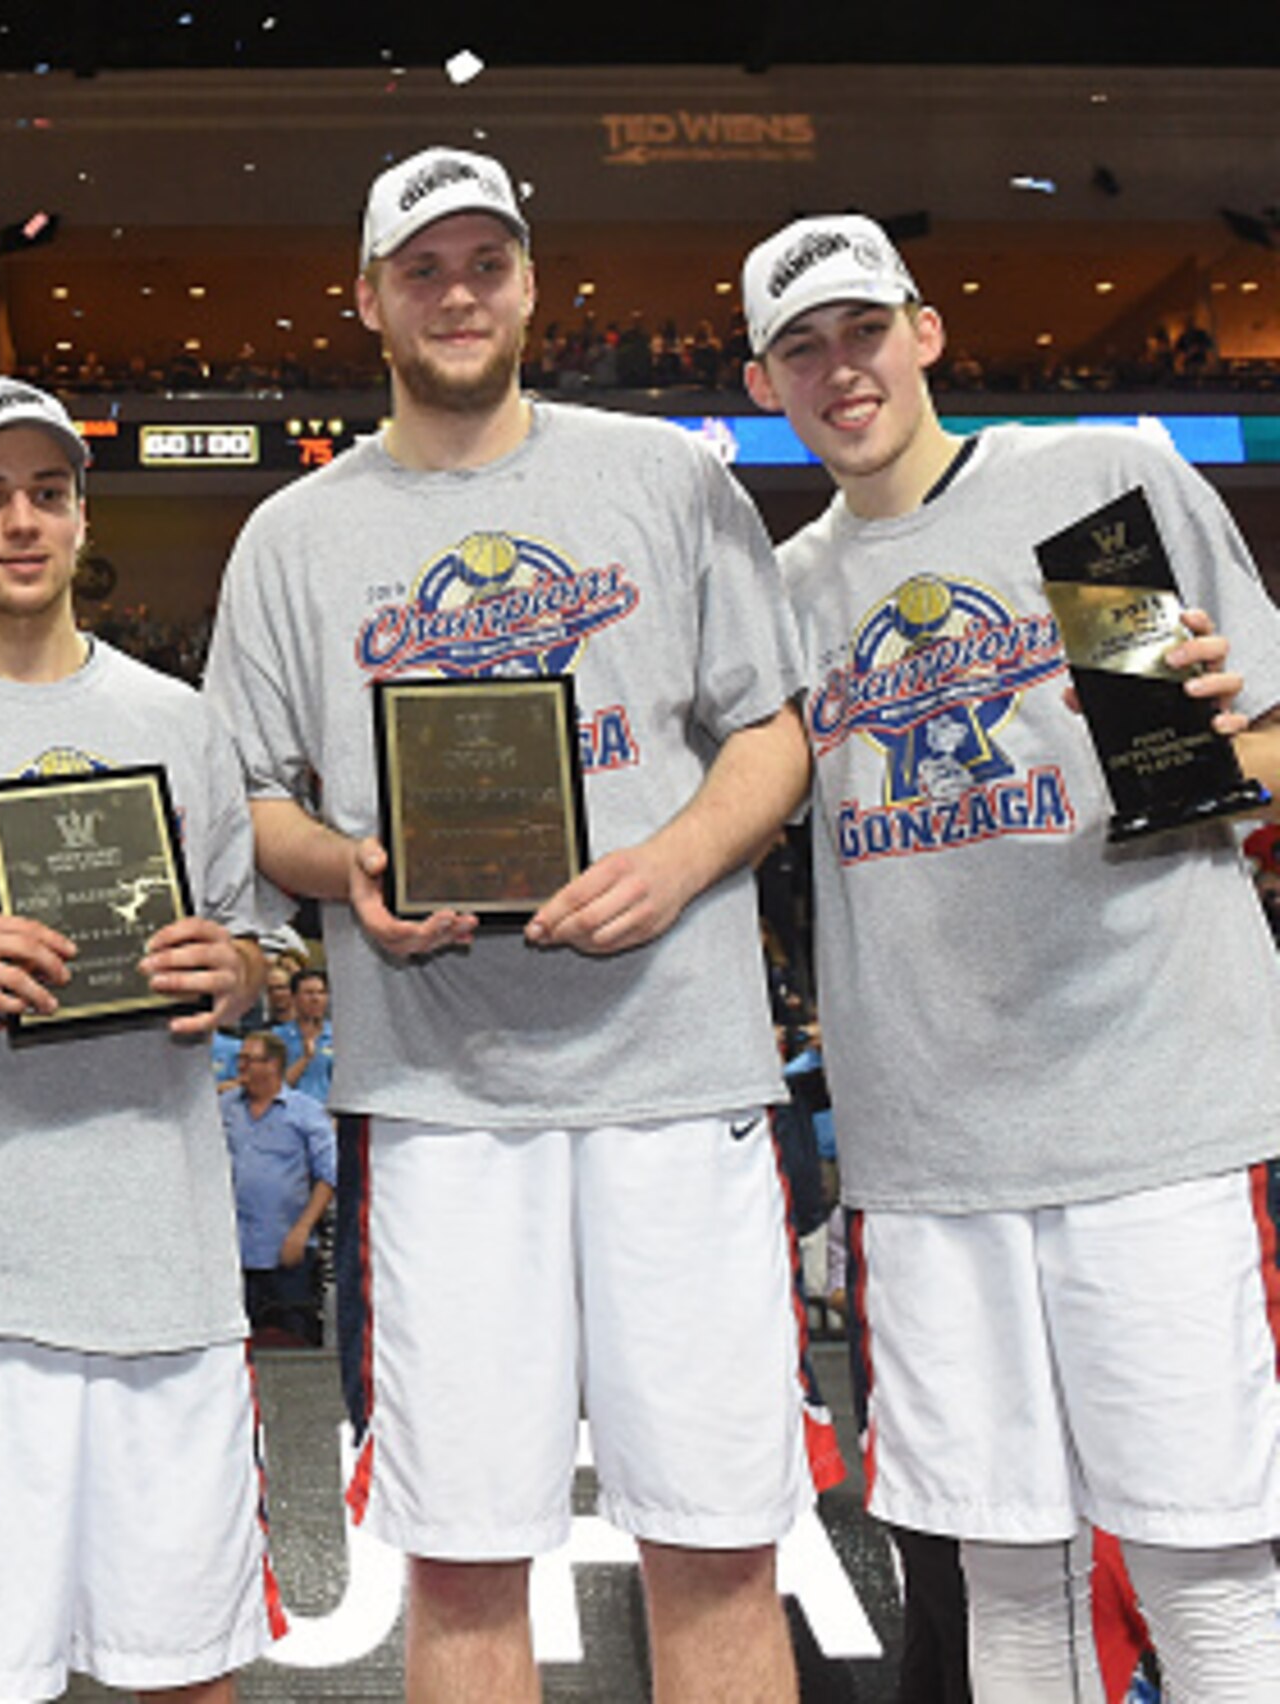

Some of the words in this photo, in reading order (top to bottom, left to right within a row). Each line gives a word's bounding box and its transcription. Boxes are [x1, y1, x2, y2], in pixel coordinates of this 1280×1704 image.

[601, 113, 677, 150] TED
[677, 109, 816, 144] WIENS
[838, 765, 1076, 866] GONZAGA
